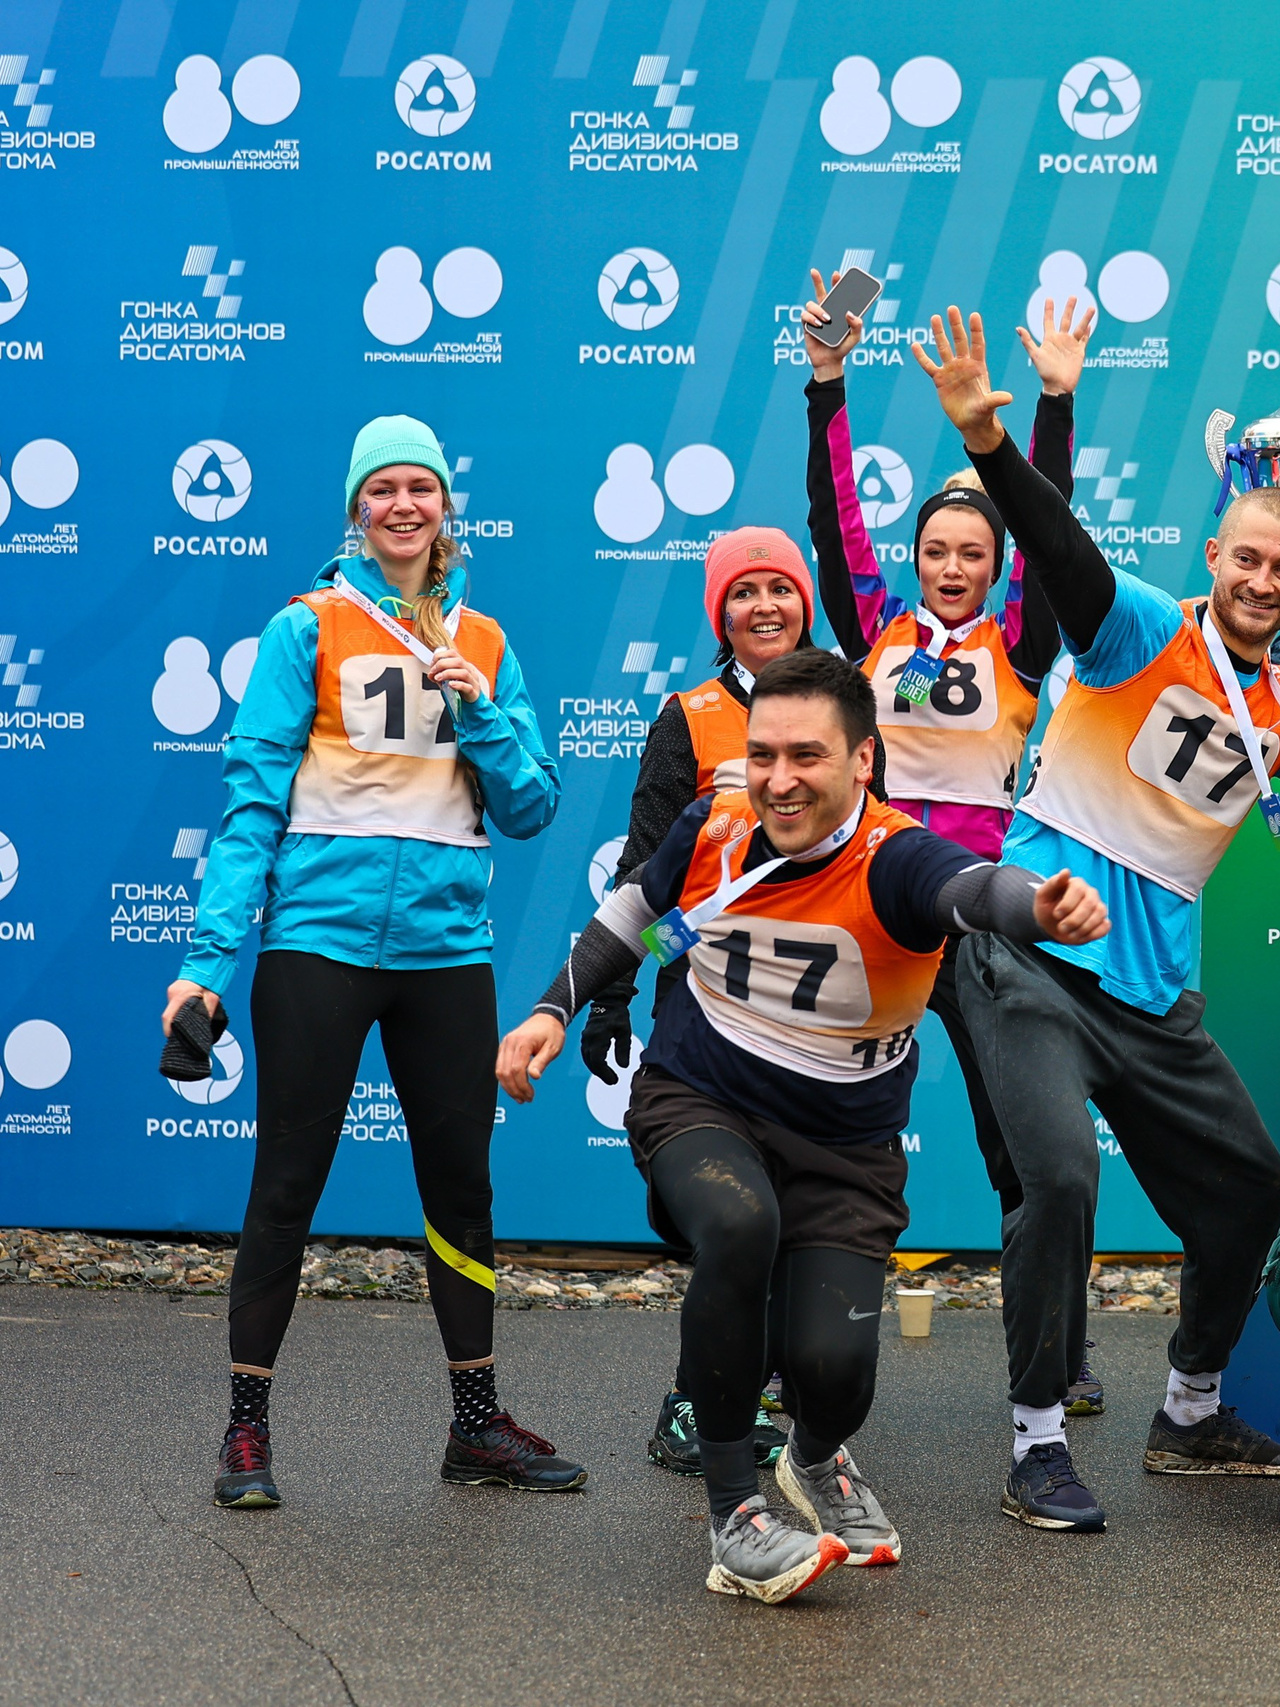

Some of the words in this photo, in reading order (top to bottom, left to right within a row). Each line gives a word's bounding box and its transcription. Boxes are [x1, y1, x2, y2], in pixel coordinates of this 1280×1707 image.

[570, 111, 650, 129] ГОНКА
[0, 131, 96, 149] ЗИОНОВ
[274, 139, 300, 152] ЛЕТ
[569, 132, 739, 153] ДИВИЗИОНОВ
[934, 141, 961, 155] ЛЕТ
[232, 147, 300, 160] АТОМНОЙ
[376, 151, 492, 171] РОСАТОМ
[569, 153, 699, 172] РОСАТОМА
[891, 150, 961, 163] АТОМНОЙ
[163, 157, 300, 170] ПРОМЫШЛЕННОСТИ
[821, 160, 961, 173] ПРОМЫШЛЕННОСТИ
[1039, 154, 1158, 174] РОСАТОМ
[120, 301, 199, 319] ГОНКА
[119, 322, 286, 342] ДИВИЗИОНОВ
[476, 332, 502, 345] ЛЕТ
[119, 343, 246, 361] РОСАТОМА
[430, 341, 502, 355] АТОМНОЙ
[1099, 346, 1169, 358] АТОМНОЙ
[1141, 337, 1169, 350] ЛЕТ
[364, 350, 502, 364] ПРОМЫШЛЕННОСТИ
[579, 344, 696, 365] РОСАТОМ
[772, 348, 905, 367] РООМА
[12, 532, 78, 544] АТОМНОЙ
[53, 523, 78, 535] ЛЕТ
[1087, 525, 1181, 544] ЗИОНОВ
[0, 541, 78, 554] ШЛЕННОСТИ
[153, 536, 268, 556] РОСАТОМ
[665, 541, 713, 551] АТОМН
[595, 551, 708, 563] ПРОМЫШЛЕННО
[903, 668, 934, 692] АТОМ
[898, 680, 927, 703] СЛЕТ
[559, 698, 640, 716] ГОНКА
[0, 711, 85, 729] ИОНОВ
[558, 719, 649, 739] ДИВИЗ
[153, 739, 227, 752] ПРОМЫШЛ
[559, 740, 647, 759] РОСАТ
[1165, 713, 1270, 804] 17
[111, 883, 189, 901] ГОНКА
[110, 904, 199, 924] ДИВИЗ
[111, 925, 196, 943] РОСАТ
[708, 929, 838, 1012] 17
[351, 1080, 400, 1101] ОНК
[4, 1113, 71, 1125] АТОМНОЙ
[46, 1104, 71, 1116] ЛЕТ
[0, 1123, 71, 1135] ЛЕННОСТИ
[146, 1118, 258, 1139] РОСАТОМ
[341, 1123, 409, 1143] РОСАТ
